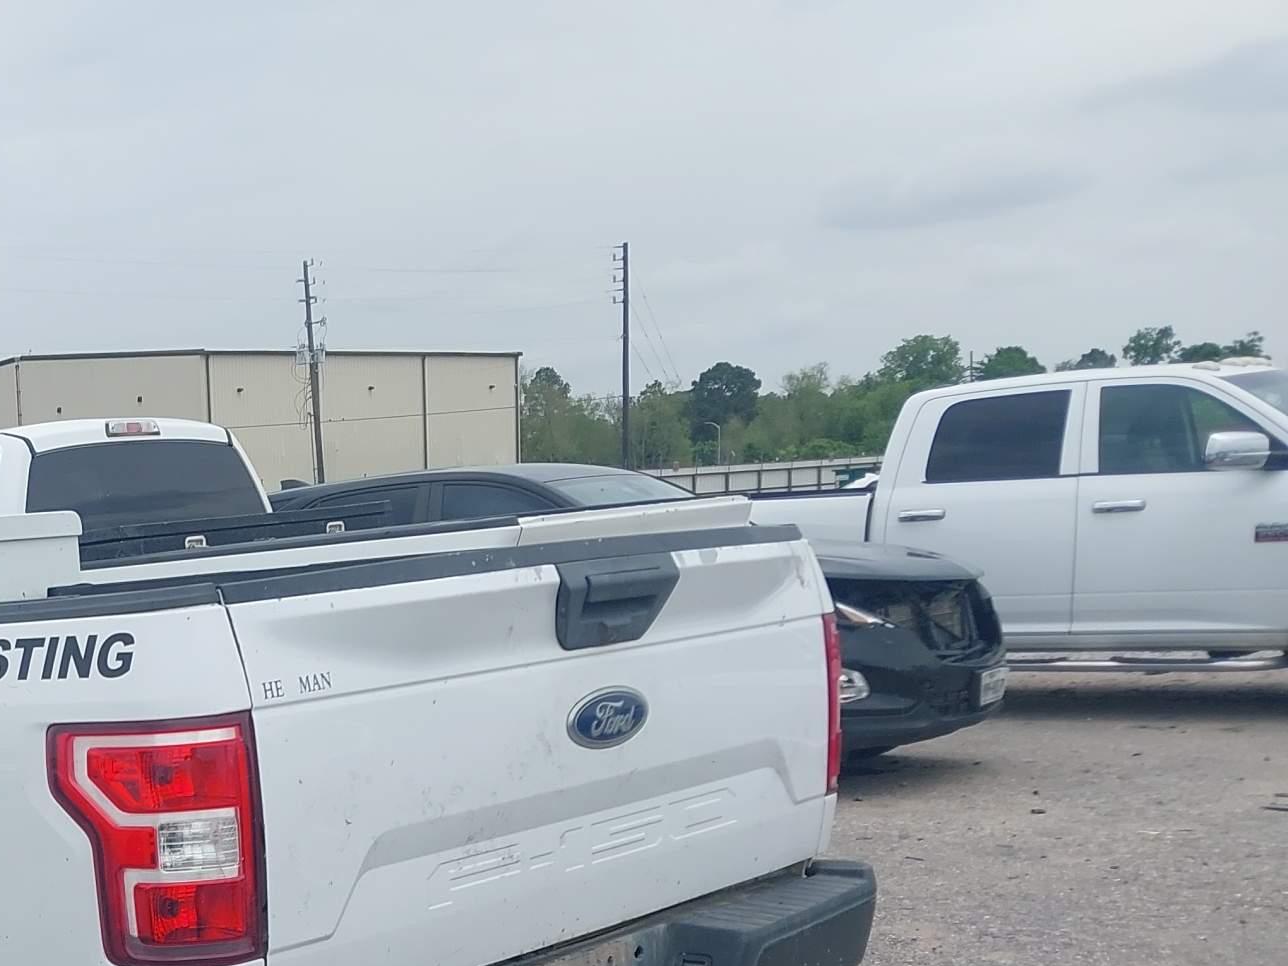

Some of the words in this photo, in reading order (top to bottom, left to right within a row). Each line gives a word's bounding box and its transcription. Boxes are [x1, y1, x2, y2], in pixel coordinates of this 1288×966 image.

[262, 679, 284, 699] HE
[299, 671, 332, 694] MAN
[591, 699, 636, 737] Ford
